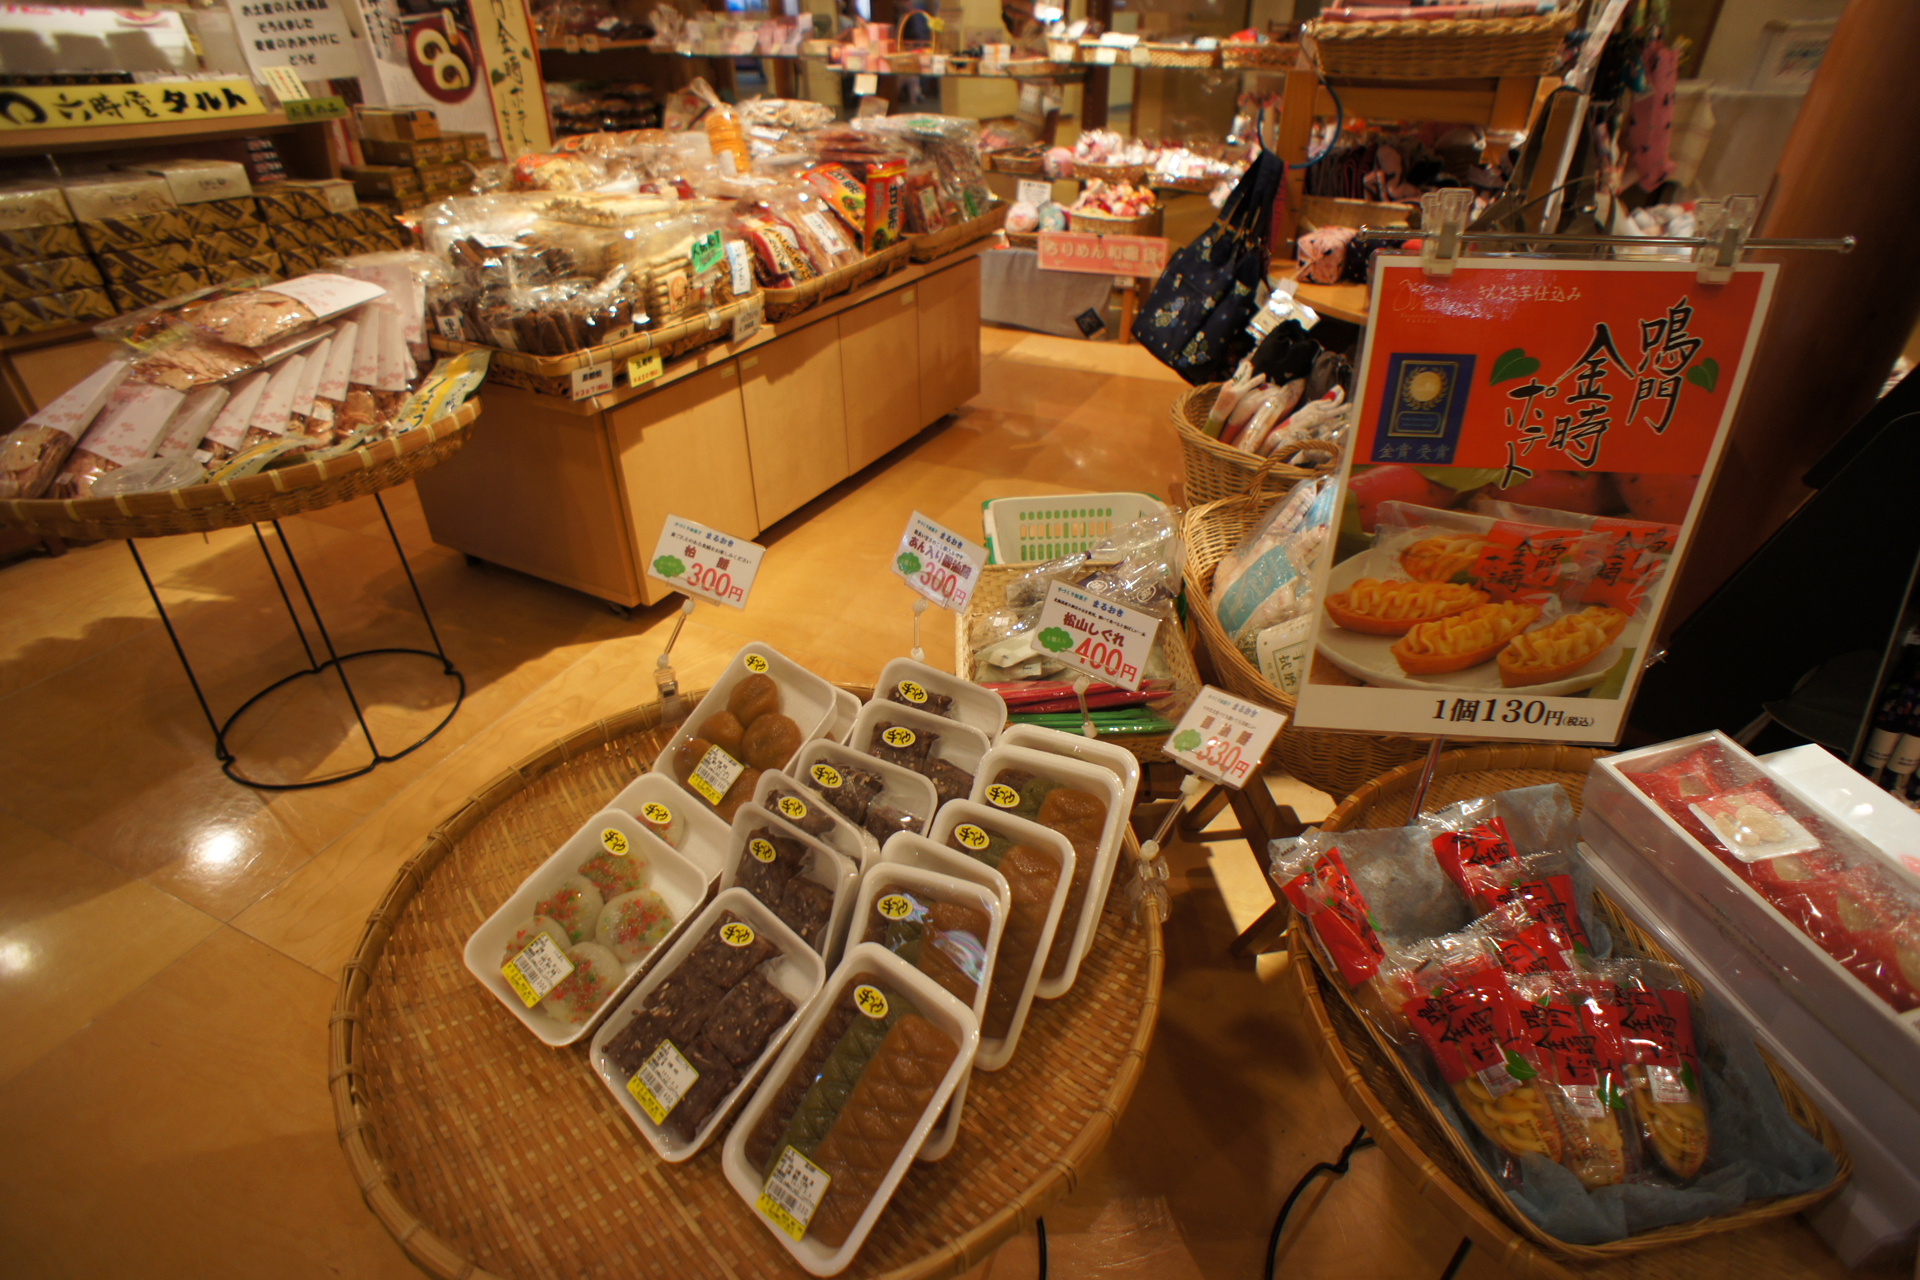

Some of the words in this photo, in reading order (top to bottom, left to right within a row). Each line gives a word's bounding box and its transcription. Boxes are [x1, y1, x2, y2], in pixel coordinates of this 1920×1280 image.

[1043, 241, 1159, 263] ちりめん和雑貨
[1626, 295, 1702, 435] 鳴門
[1547, 322, 1636, 468] 金時
[1500, 378, 1560, 490] ポテト
[704, 530, 735, 548] まるおき
[939, 530, 964, 550] まるおき
[684, 560, 747, 604] 300円
[918, 559, 970, 607] 300円
[1061, 610, 1127, 648] 松山しぐれ
[1091, 598, 1125, 618] まるおき
[1072, 633, 1141, 685] 400円
[1194, 733, 1256, 780] 330円
